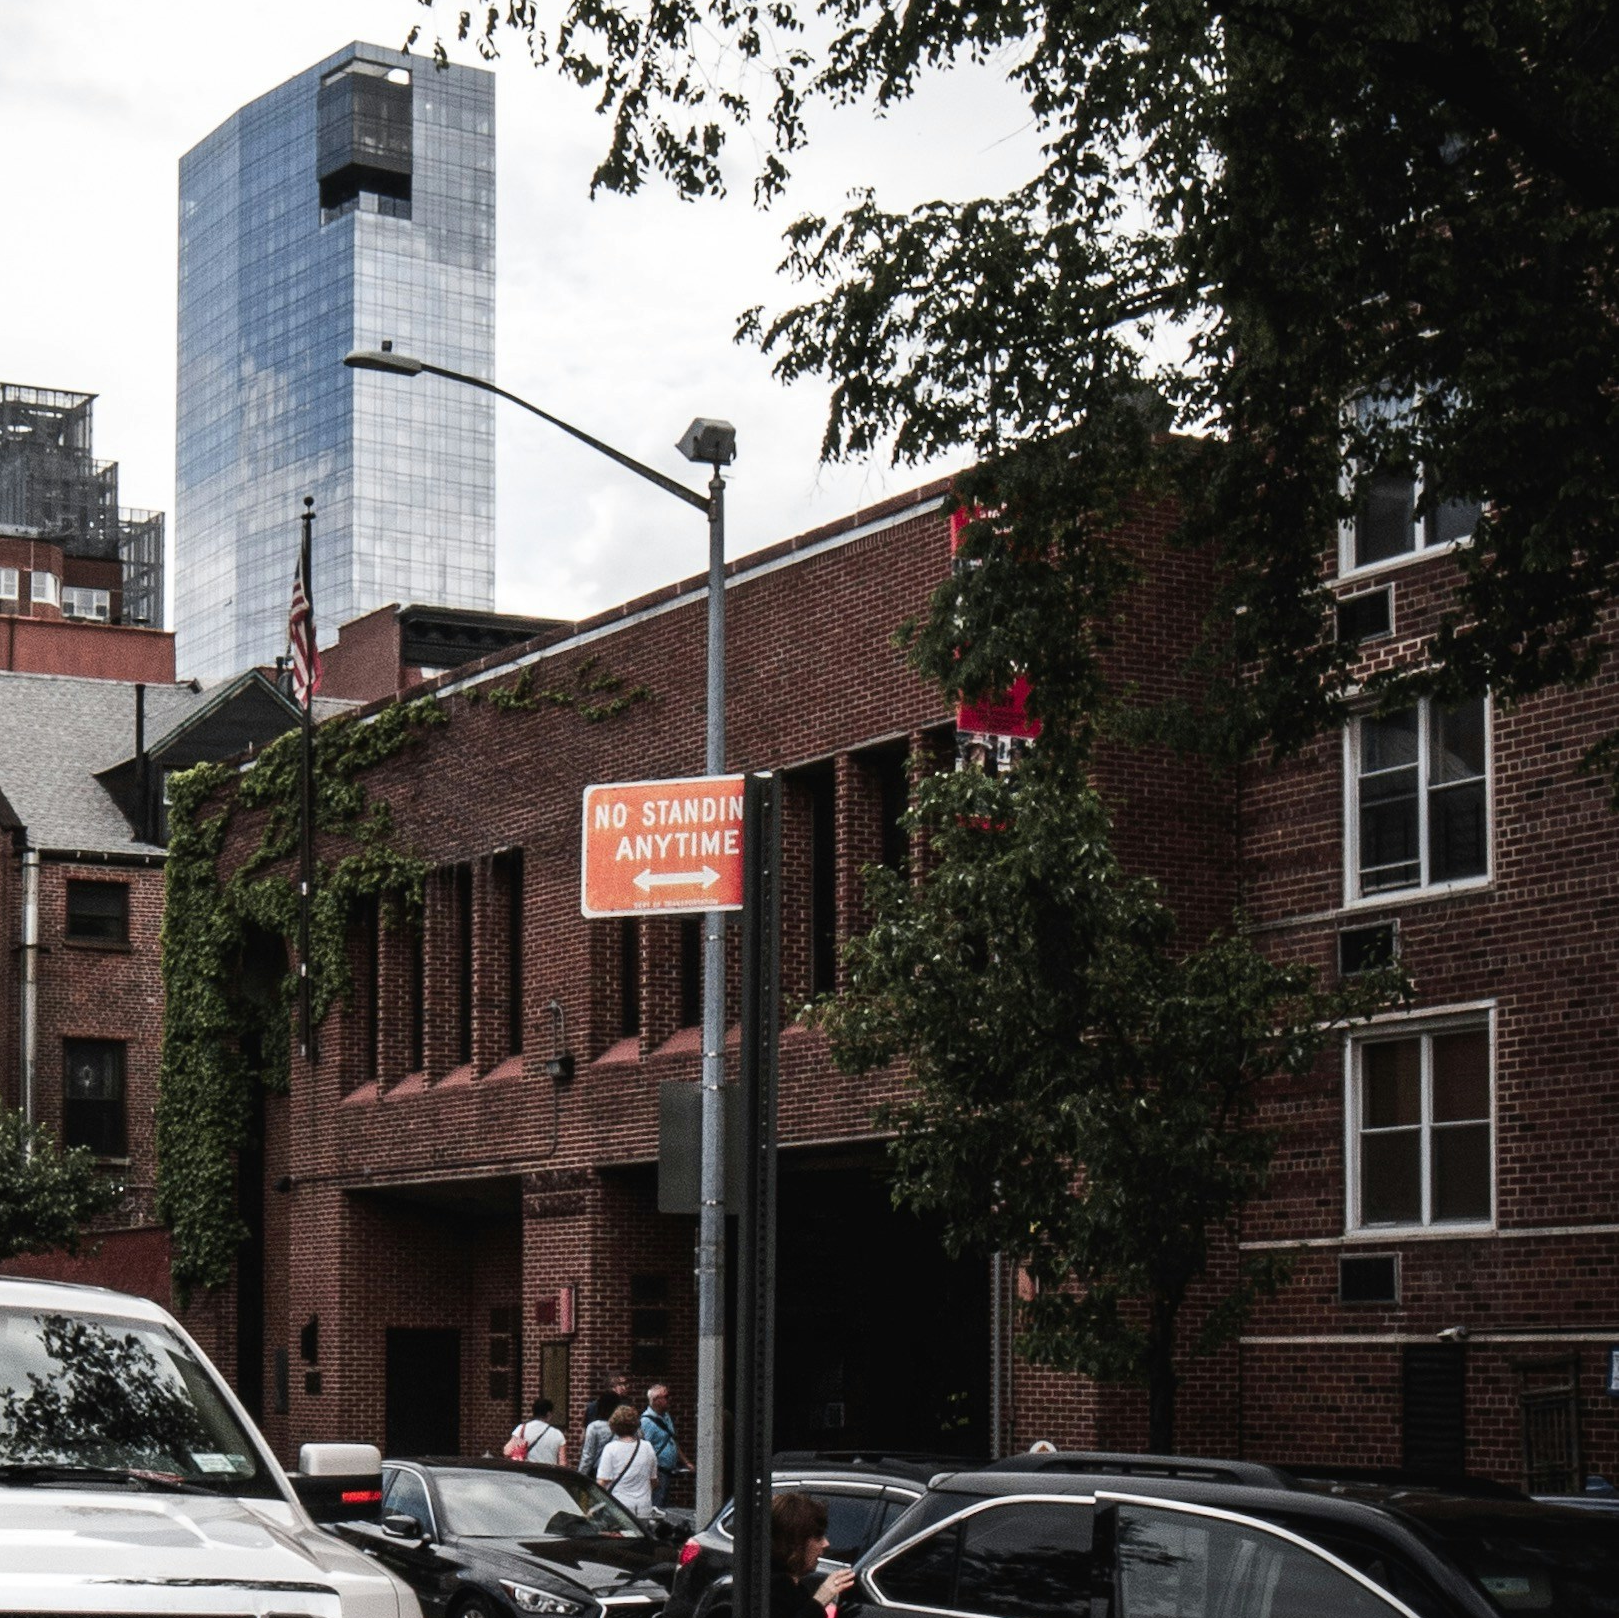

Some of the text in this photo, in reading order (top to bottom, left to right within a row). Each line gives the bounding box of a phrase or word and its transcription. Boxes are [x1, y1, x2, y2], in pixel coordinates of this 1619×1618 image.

[595, 796, 744, 829] NO STANDIN
[615, 830, 739, 861] ANYTIME
